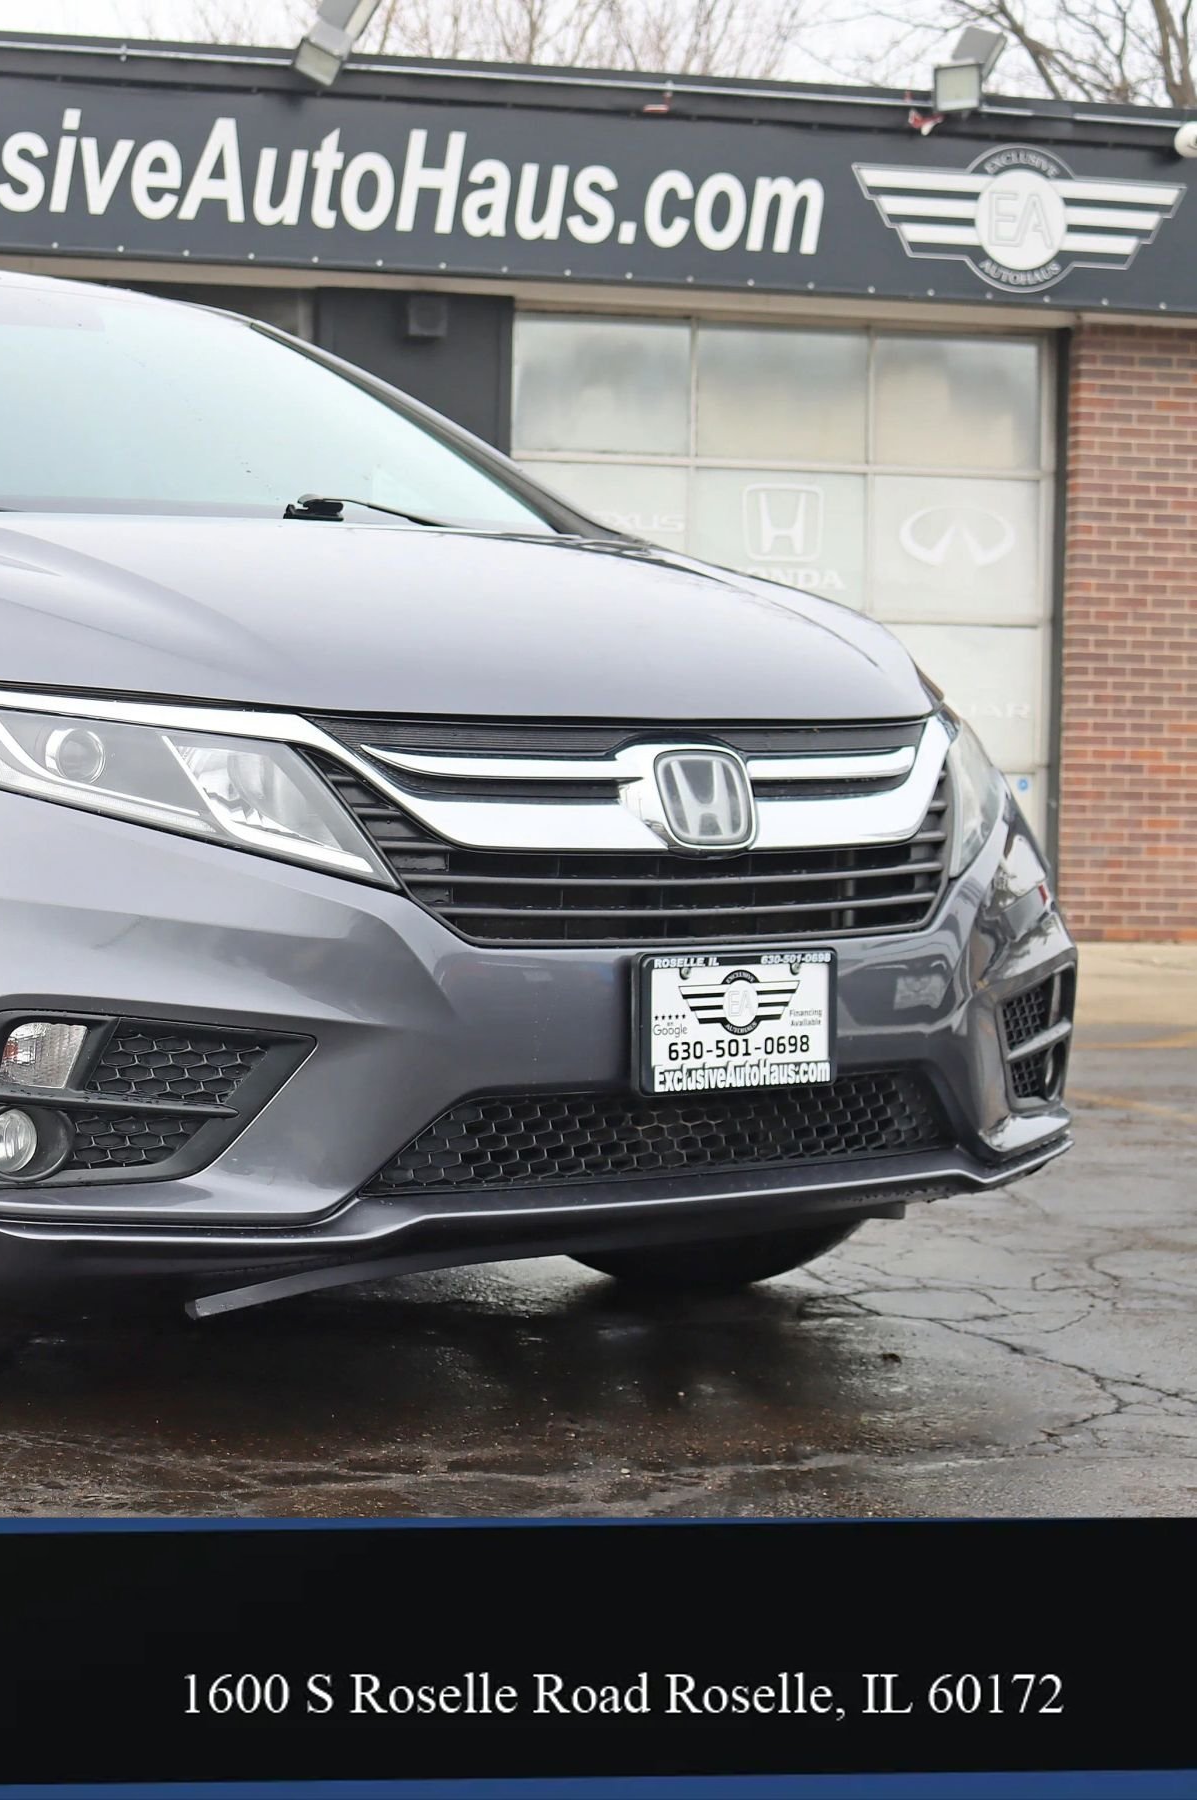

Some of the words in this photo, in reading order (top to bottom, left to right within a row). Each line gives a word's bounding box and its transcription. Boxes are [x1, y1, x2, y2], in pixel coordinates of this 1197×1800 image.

[984, 150, 1061, 178] EXCLUSIVE
[987, 190, 1055, 250] EA
[977, 259, 1062, 286] AUTOHAUS
[708, 956, 720, 967] IL
[761, 953, 831, 965] 630-501-0698
[789, 1008, 822, 1019] Financing
[790, 1018, 821, 1027] Available
[653, 1022, 688, 1038] Google
[668, 1035, 810, 1061] 630-501-0698
[654, 1060, 831, 1093] ExclusiveAutoHaus.com
